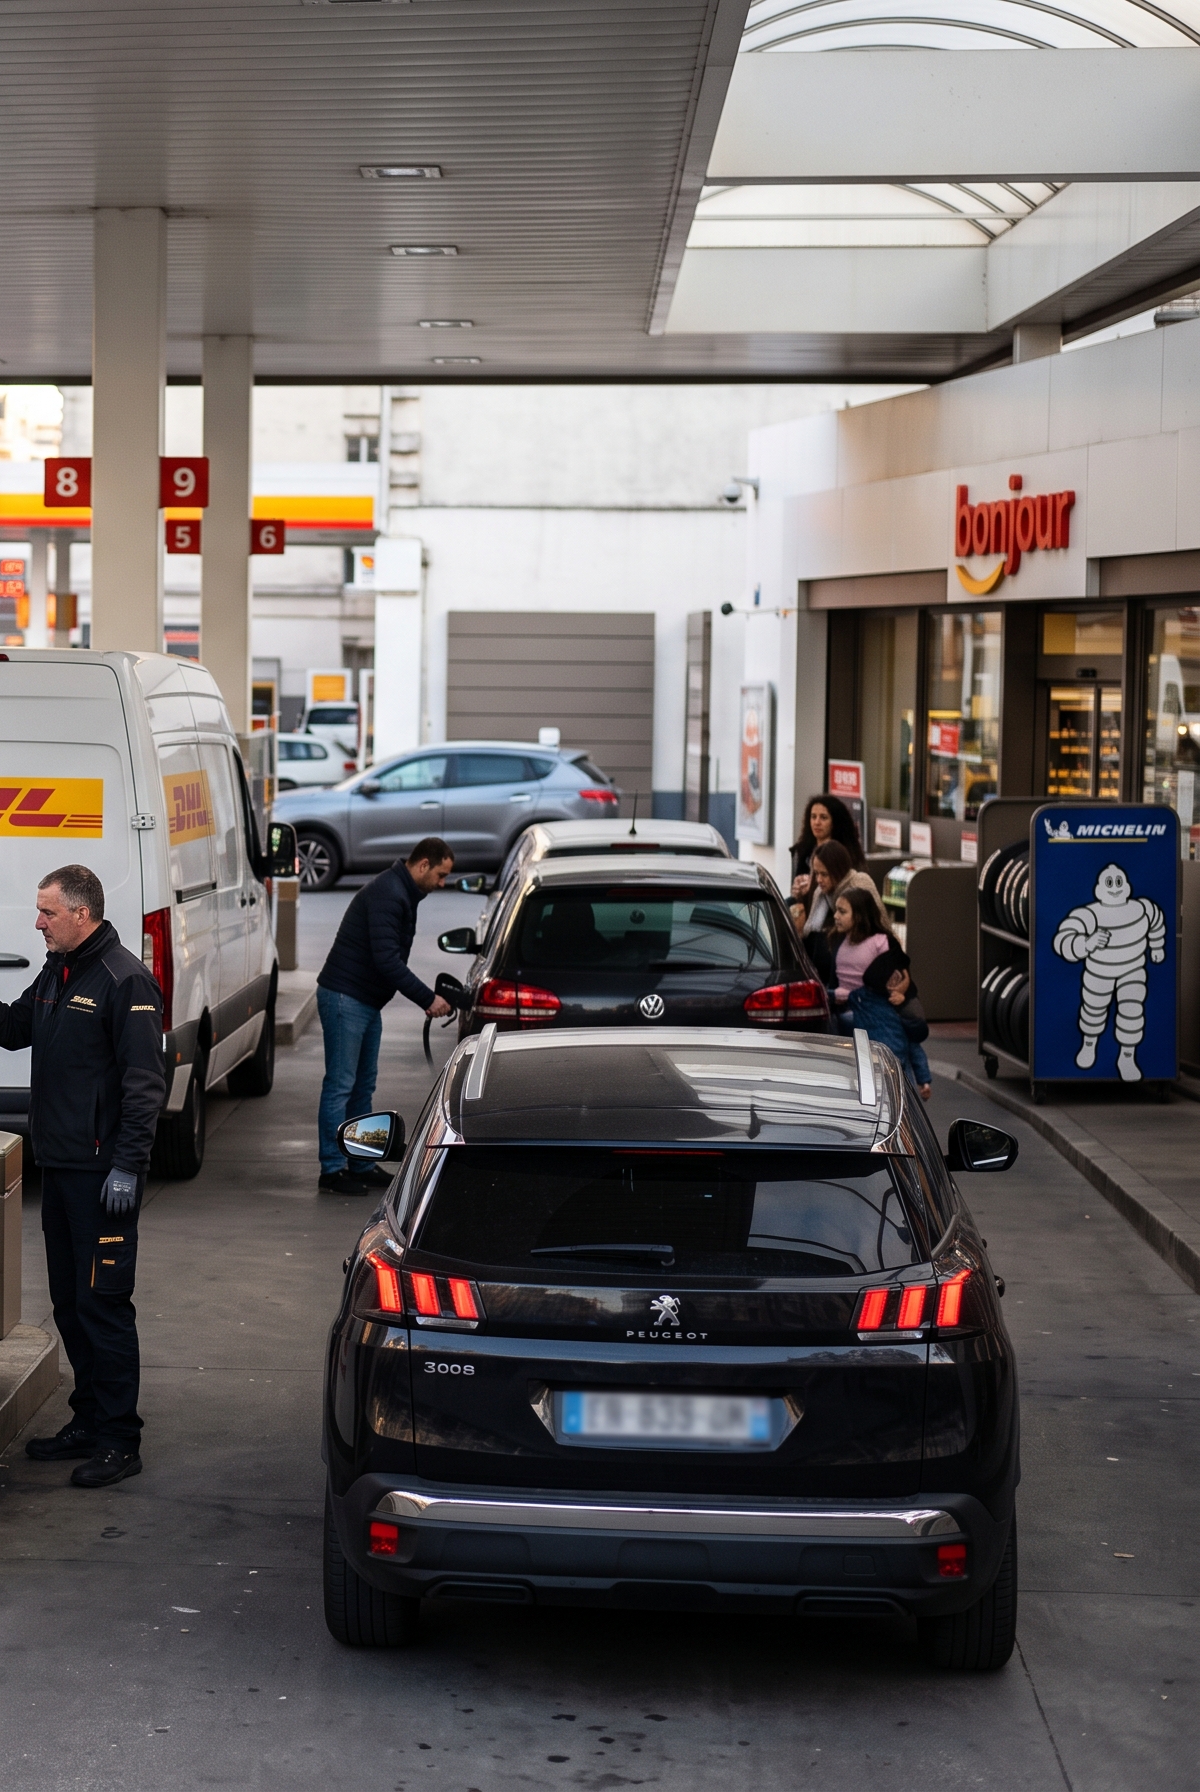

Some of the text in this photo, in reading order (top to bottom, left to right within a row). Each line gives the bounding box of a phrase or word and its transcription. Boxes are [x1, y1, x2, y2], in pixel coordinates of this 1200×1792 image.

[55, 466, 79, 497] 8
[173, 467, 196, 497] 9
[259, 525, 277, 548] 6
[955, 474, 1076, 576] bonjour
[175, 526, 191, 548] 5
[1076, 824, 1167, 836] MICHELIN
[626, 1330, 708, 1340] PEUGEOT
